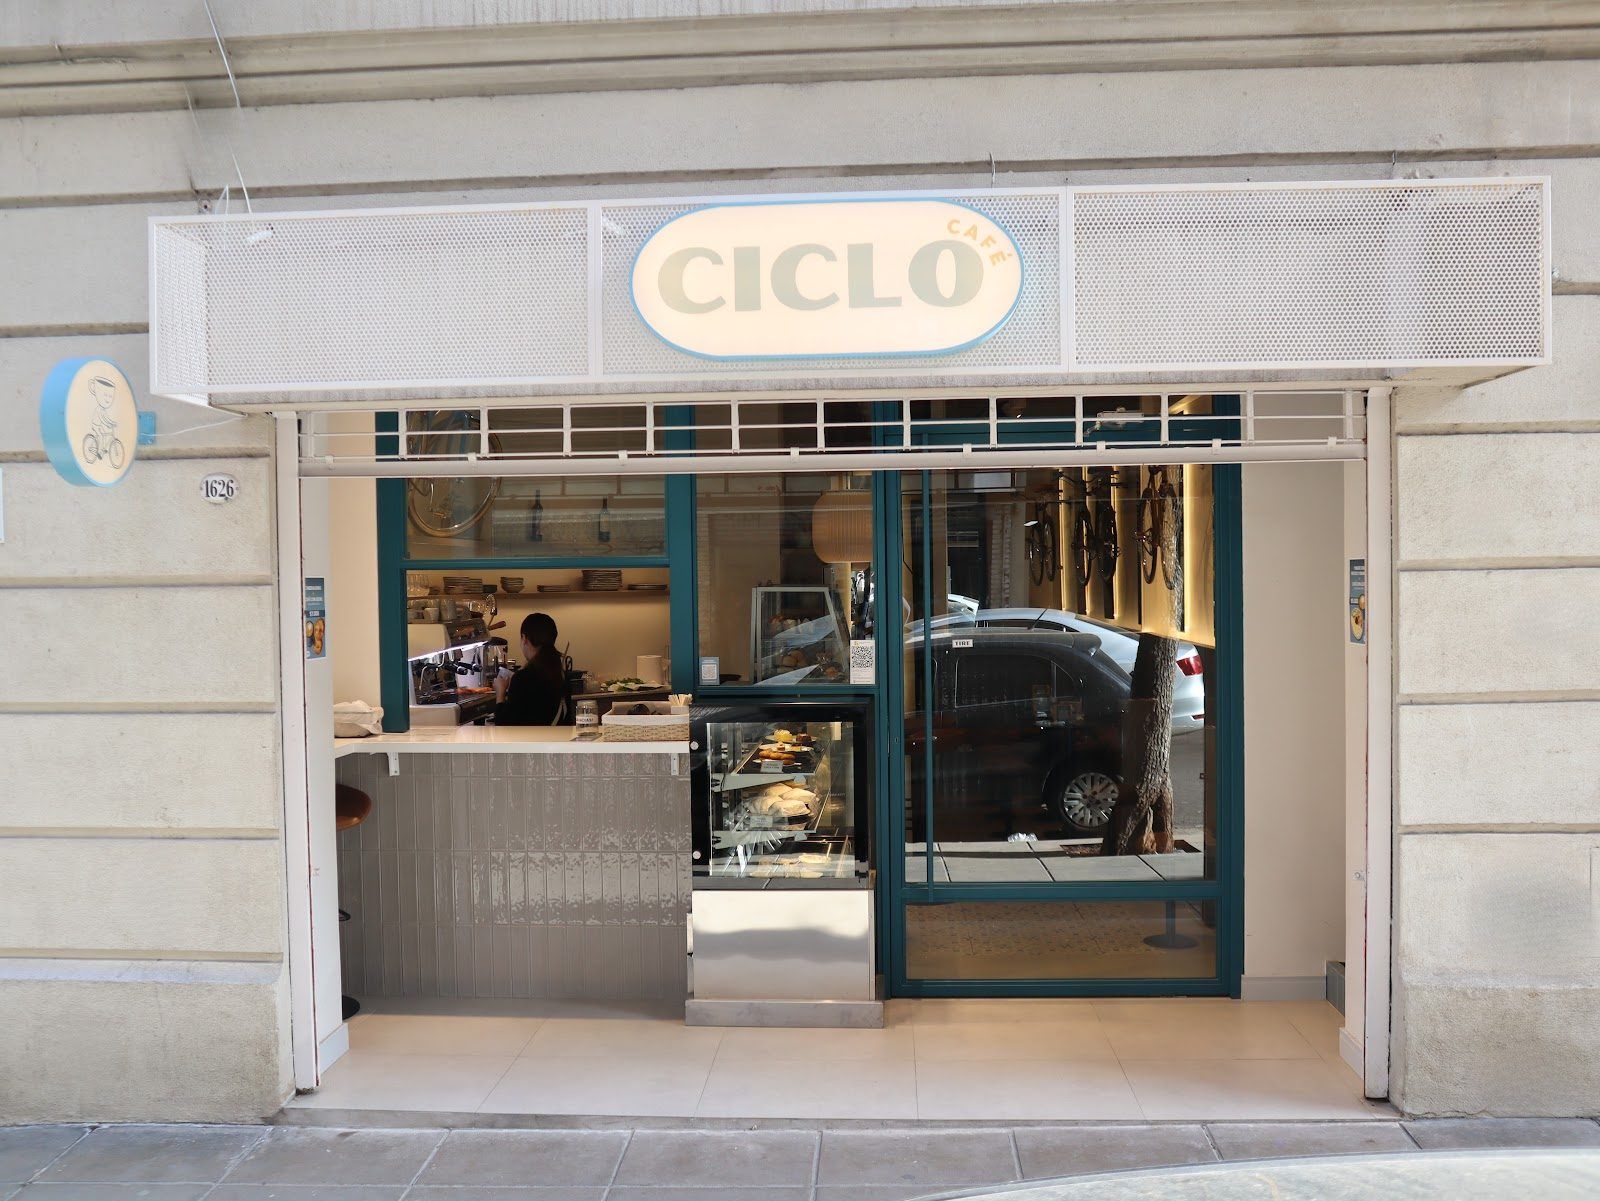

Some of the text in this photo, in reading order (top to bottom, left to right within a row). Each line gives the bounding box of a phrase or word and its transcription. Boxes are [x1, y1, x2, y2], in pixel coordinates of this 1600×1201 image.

[946, 218, 1013, 267] CAFÉ
[657, 239, 985, 315] CICLO
[204, 479, 234, 498] 1626
